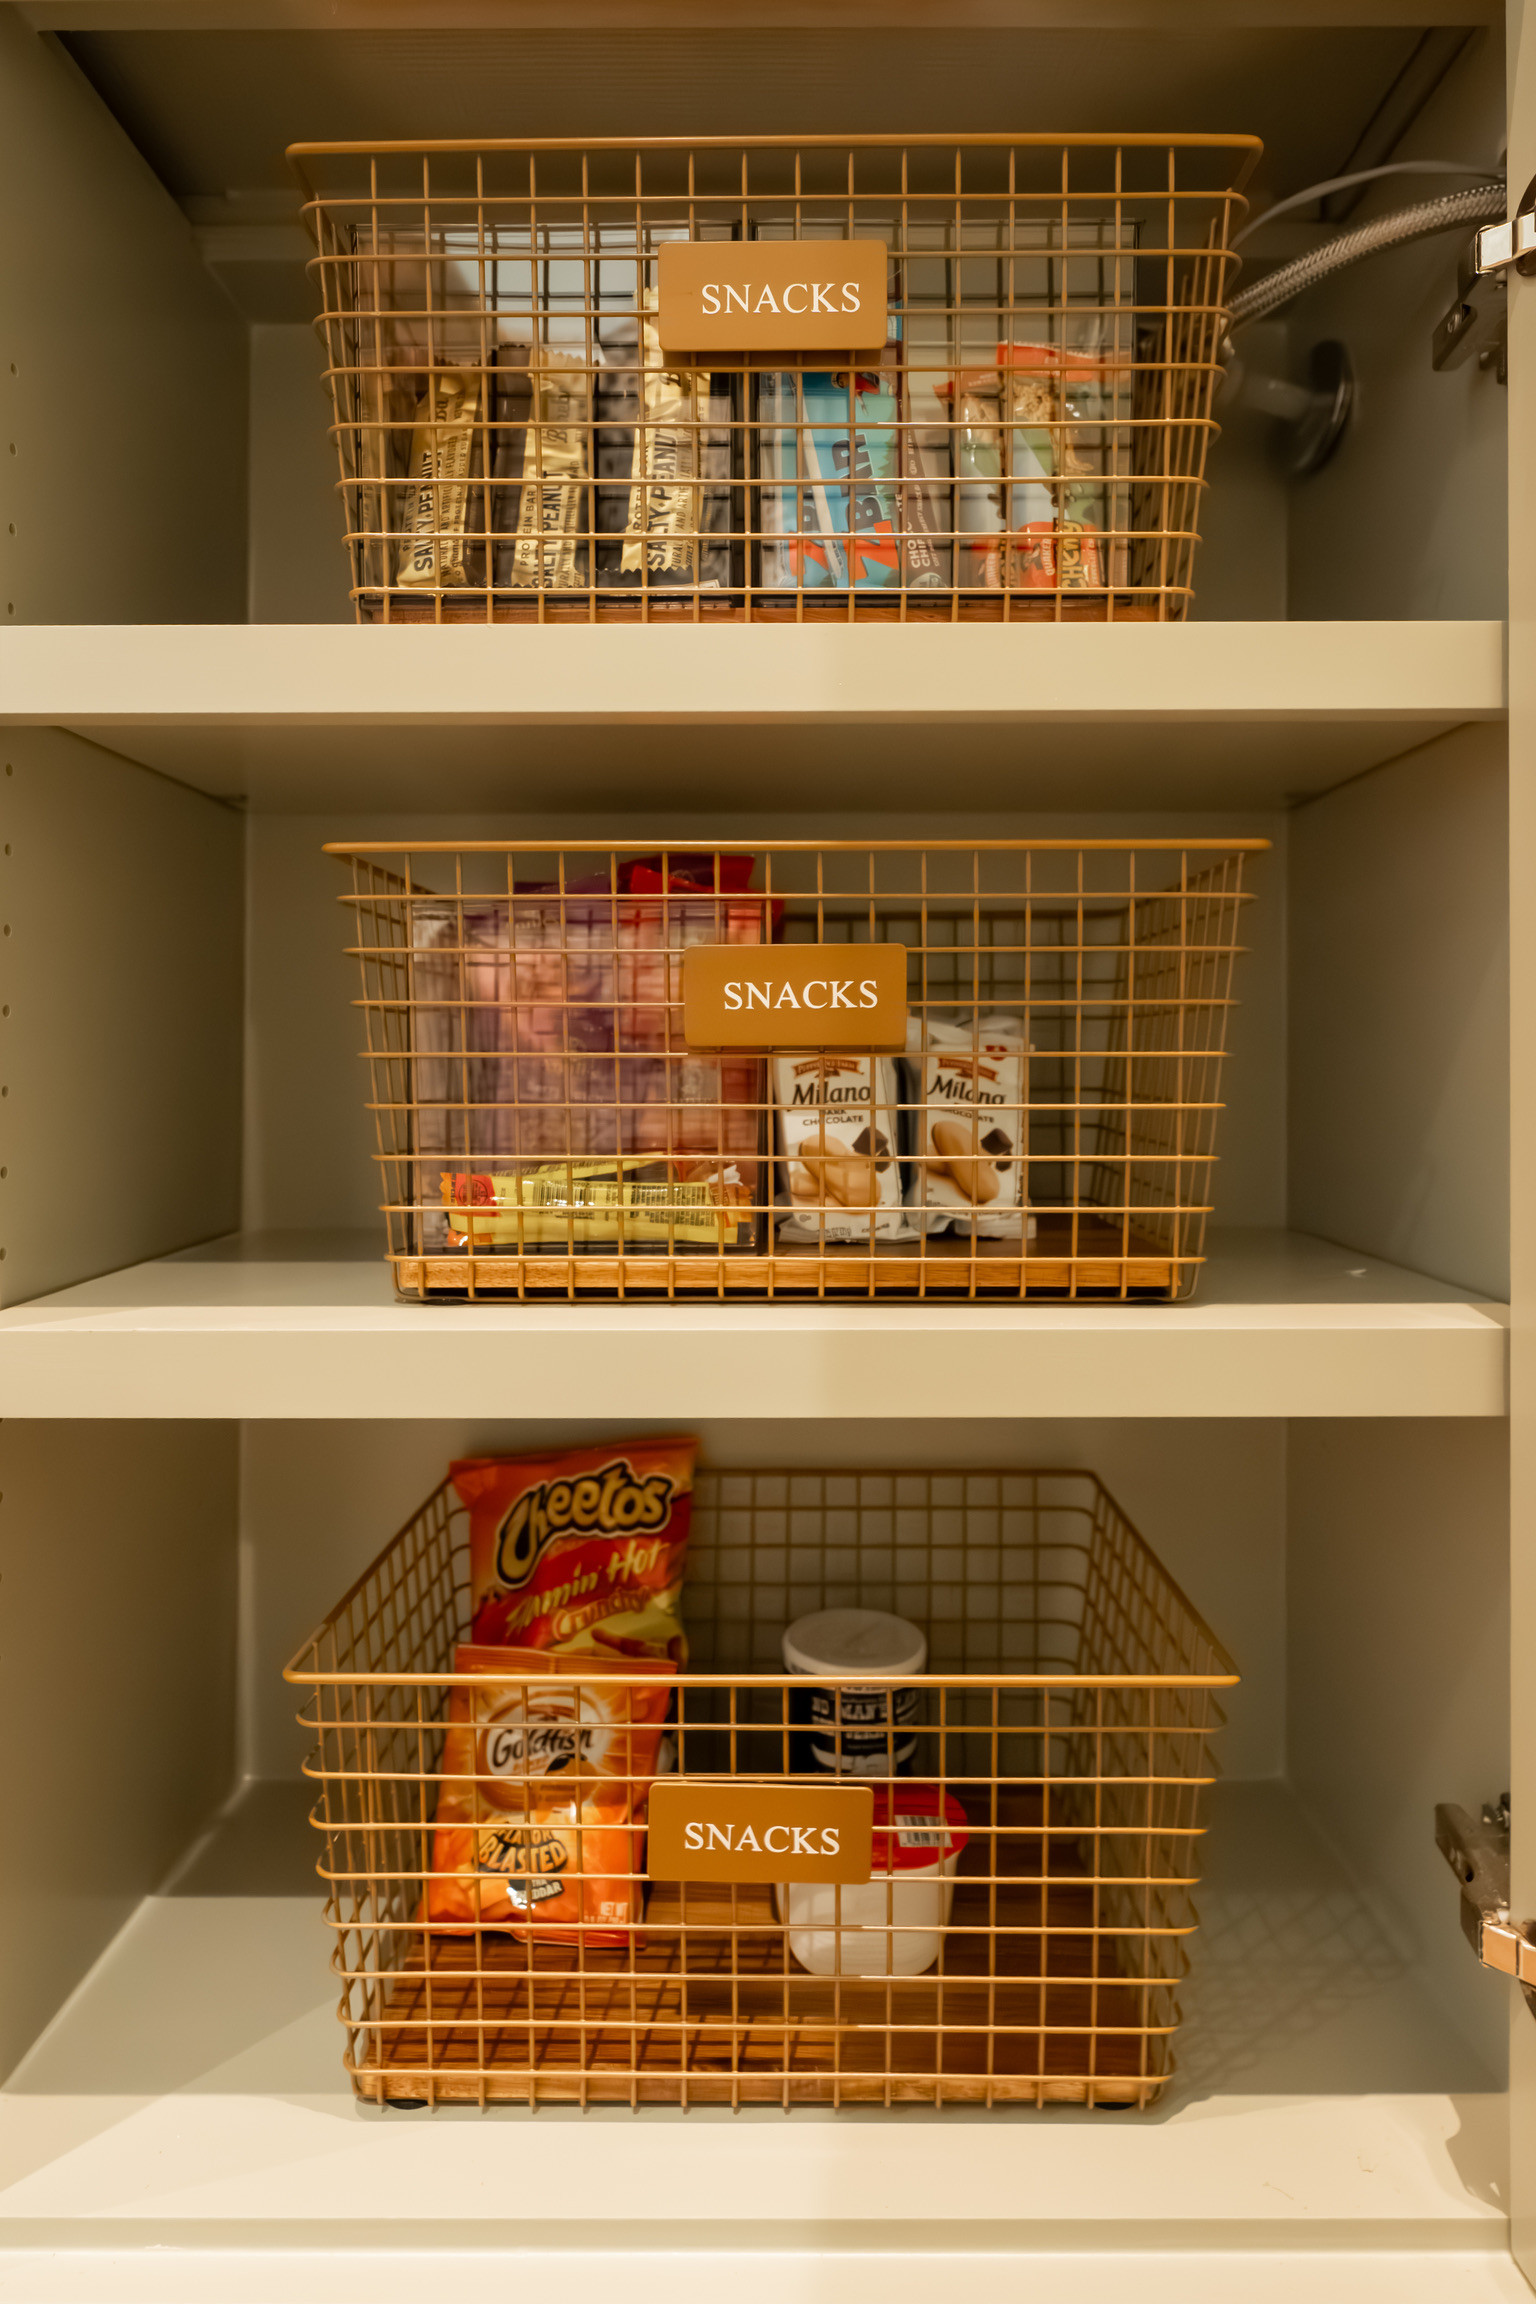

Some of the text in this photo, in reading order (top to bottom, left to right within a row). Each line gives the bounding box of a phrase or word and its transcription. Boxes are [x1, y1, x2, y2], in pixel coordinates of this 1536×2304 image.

[701, 282, 861, 315] SNACKS
[542, 470, 563, 532] PEANUT
[674, 511, 687, 530] AND
[520, 490, 536, 567] PROEIN BAR
[646, 506, 669, 567] SATY
[1042, 537, 1056, 577] QUAKER
[724, 980, 878, 1010] SNACKS
[792, 1080, 872, 1106] Milano
[926, 1075, 1007, 1106] Milano
[802, 1115, 864, 1127] CHCOLATE
[498, 1463, 673, 1585] Cheetos
[607, 1539, 671, 1584] Hot
[553, 1586, 652, 1641] Crunchy
[478, 1835, 568, 1874] BLASTED
[684, 1822, 840, 1856] SNACKS
